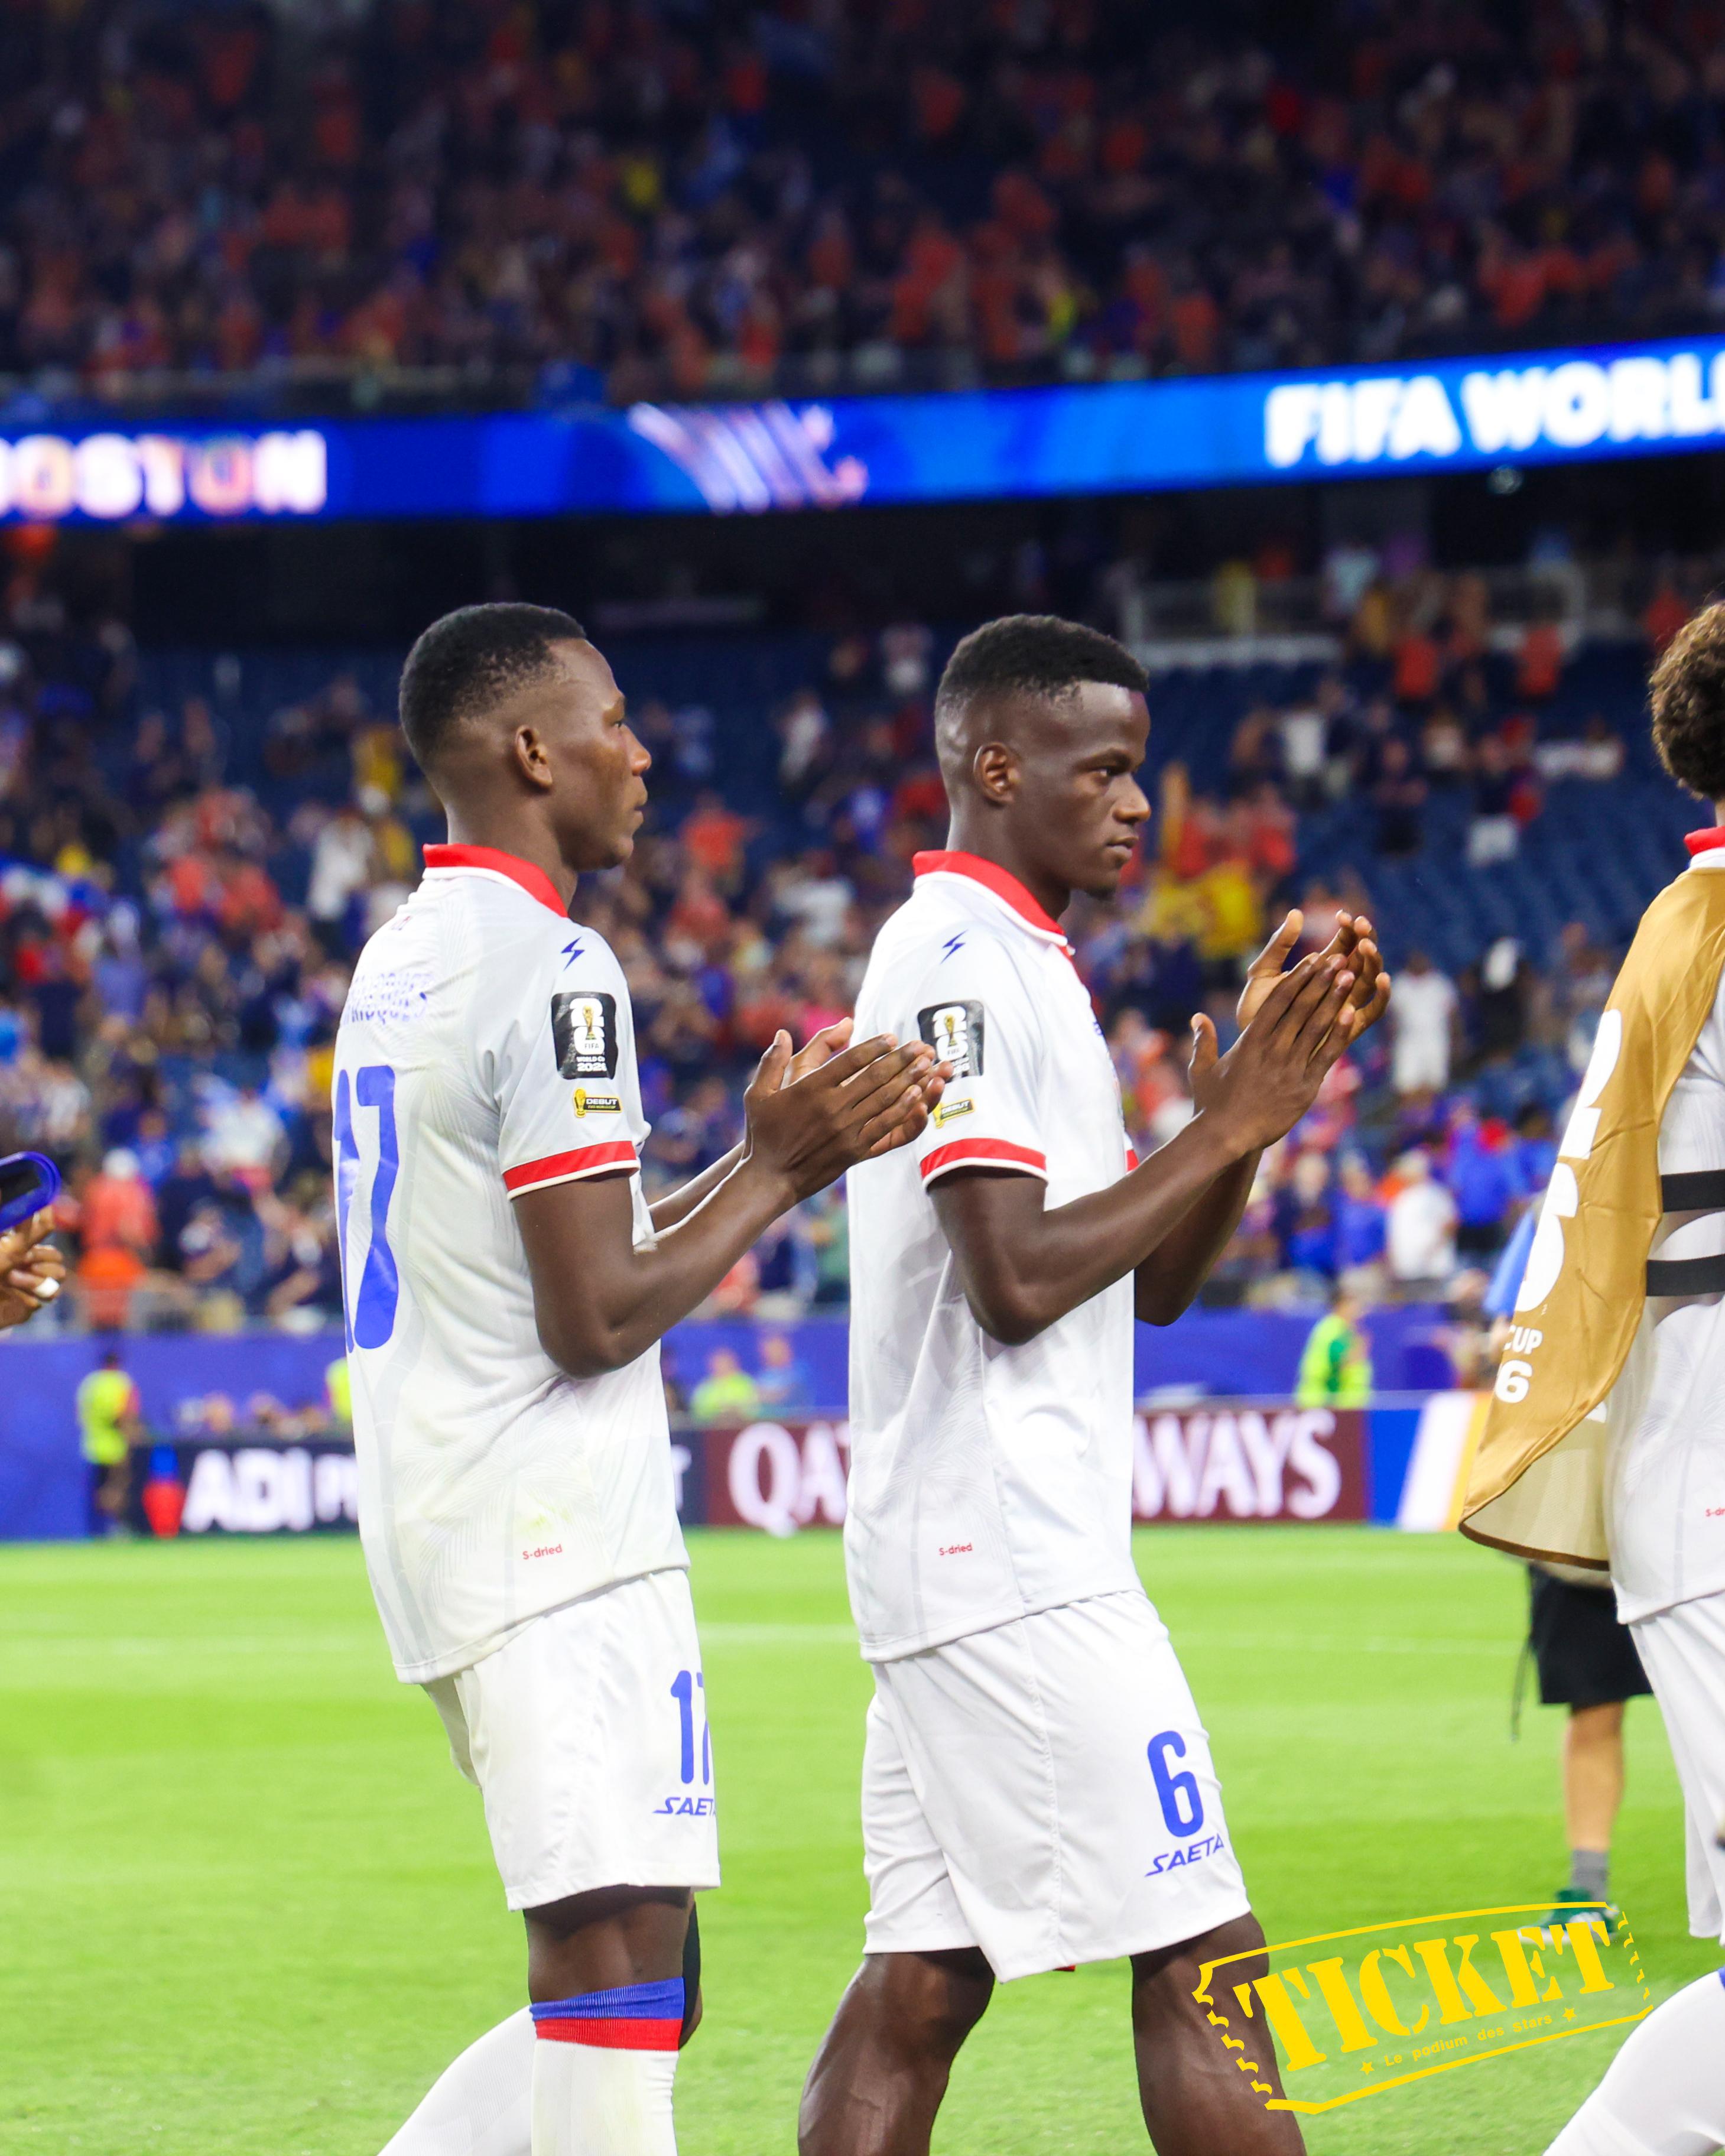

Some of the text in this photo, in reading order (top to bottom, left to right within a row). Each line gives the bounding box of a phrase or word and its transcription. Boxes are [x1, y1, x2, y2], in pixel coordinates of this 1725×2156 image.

[1264, 351, 1725, 469] FIFA WORL
[0, 430, 327, 519] OSTON
[1495, 1360, 1532, 1403] 6
[181, 1447, 314, 1532] ADI
[727, 1420, 851, 1539] QA
[1133, 1407, 1342, 1518] WAYS
[522, 1543, 563, 1560] S-dried
[938, 1541, 973, 1556] S-dried
[1147, 1730, 1204, 1837] 6
[1145, 1833, 1224, 1878] SAETA
